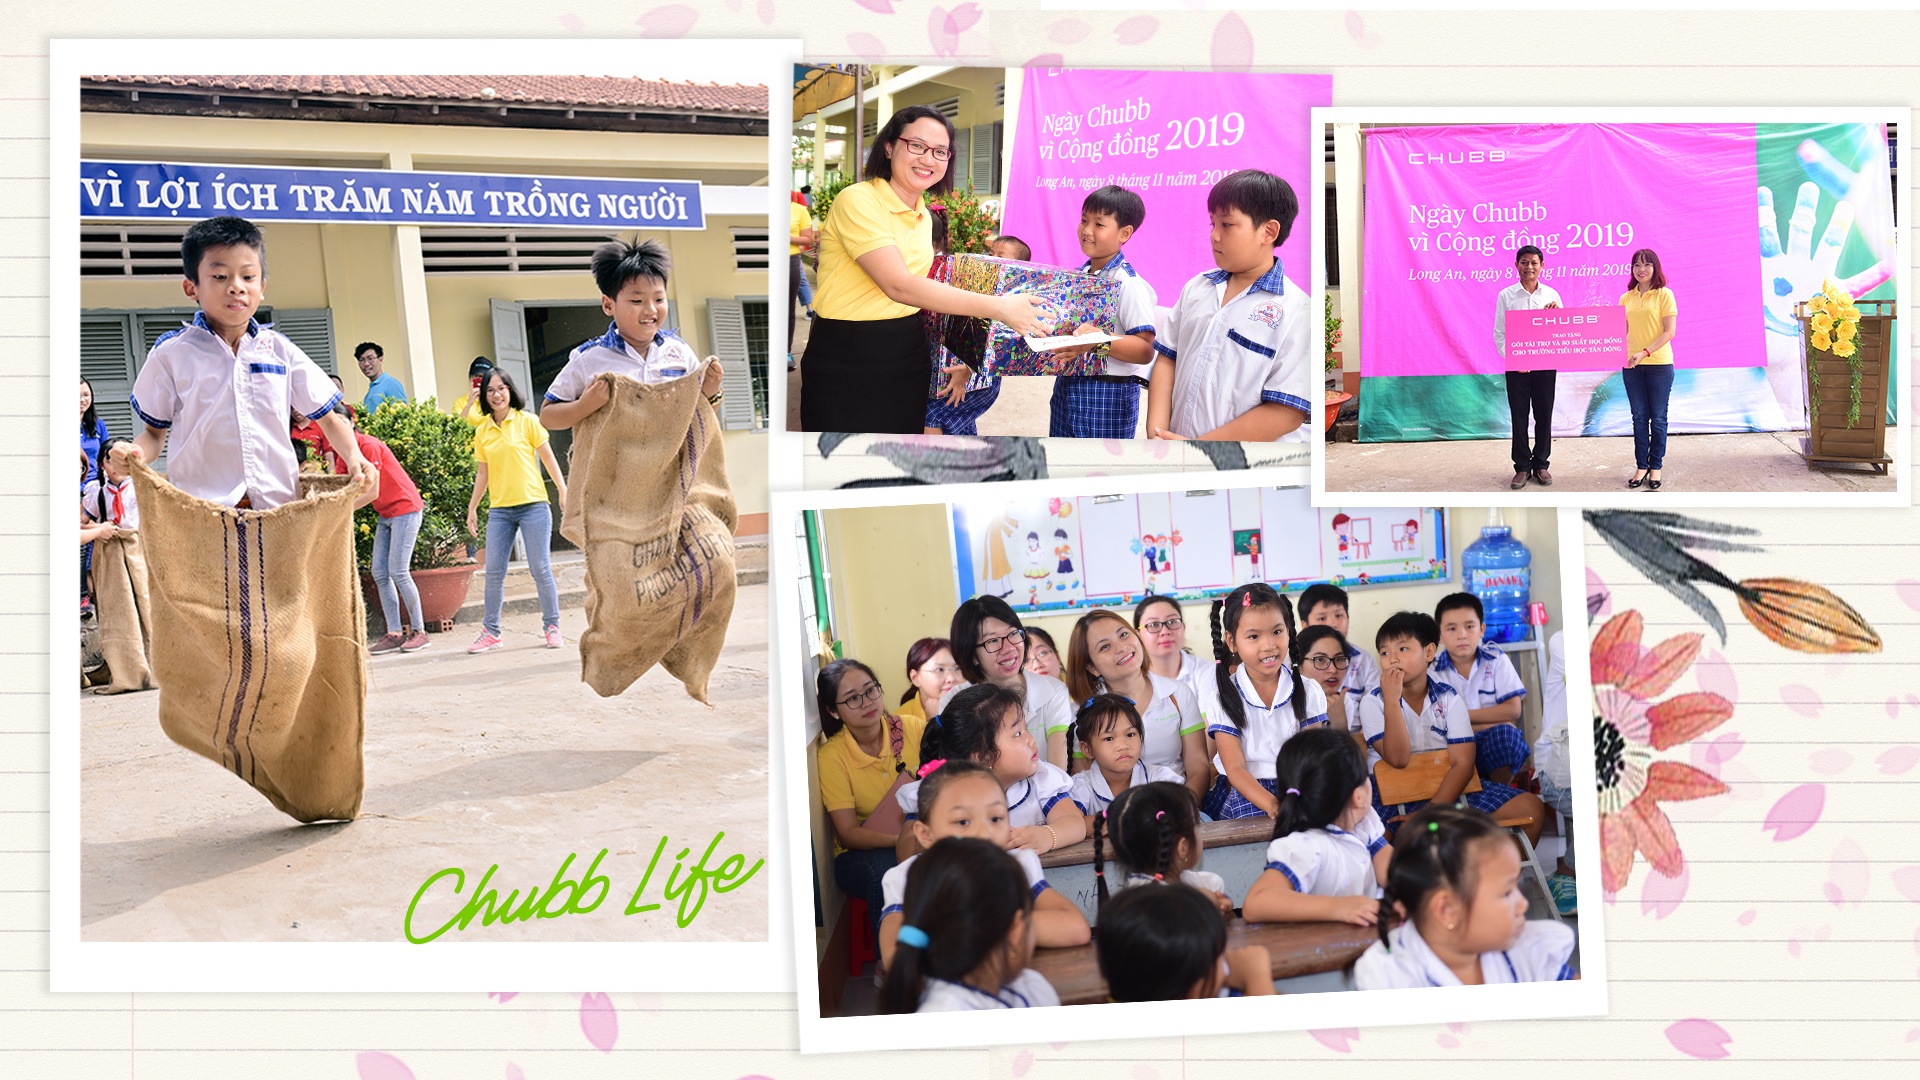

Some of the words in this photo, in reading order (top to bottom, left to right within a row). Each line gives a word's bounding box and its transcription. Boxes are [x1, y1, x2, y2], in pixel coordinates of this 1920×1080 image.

[1041, 111, 1083, 137] Ngày
[1087, 97, 1151, 128] Chubb
[1039, 140, 1055, 160] vì
[1057, 137, 1104, 164] Cộng
[1107, 127, 1160, 159] đồng
[1164, 111, 1246, 151] 2019
[1408, 150, 1506, 165] CHUBB
[80, 169, 124, 208] VÌ
[136, 176, 202, 216] LỢI
[211, 172, 279, 211] ÍCH
[288, 178, 393, 214] TRĂM
[400, 181, 476, 216] NĂM
[483, 179, 592, 218] TRỒNG
[598, 186, 689, 221] NGƯỜI
[1035, 175, 1059, 191] Long
[1059, 175, 1076, 189] An,
[1078, 174, 1106, 191] ngày
[1106, 174, 1115, 187] 8
[1116, 172, 1151, 191] tháng
[1151, 172, 1164, 187] 11
[1165, 170, 1197, 186] năm
[1408, 204, 1466, 229] Ngày
[1472, 200, 1547, 224] Chubb
[1408, 231, 1429, 252] vì
[1436, 231, 1496, 257] Cộng
[1502, 225, 1560, 255] đồng
[1565, 222, 1635, 249] 2019
[1408, 268, 1442, 283] Long
[1443, 268, 1467, 282] An,
[1470, 267, 1502, 283] ngày
[1504, 266, 1513, 280] 8
[1556, 265, 1567, 278] 11
[1569, 264, 1599, 278] năm
[1601, 263, 1632, 277] 2019
[1532, 315, 1598, 326] CHUBB
